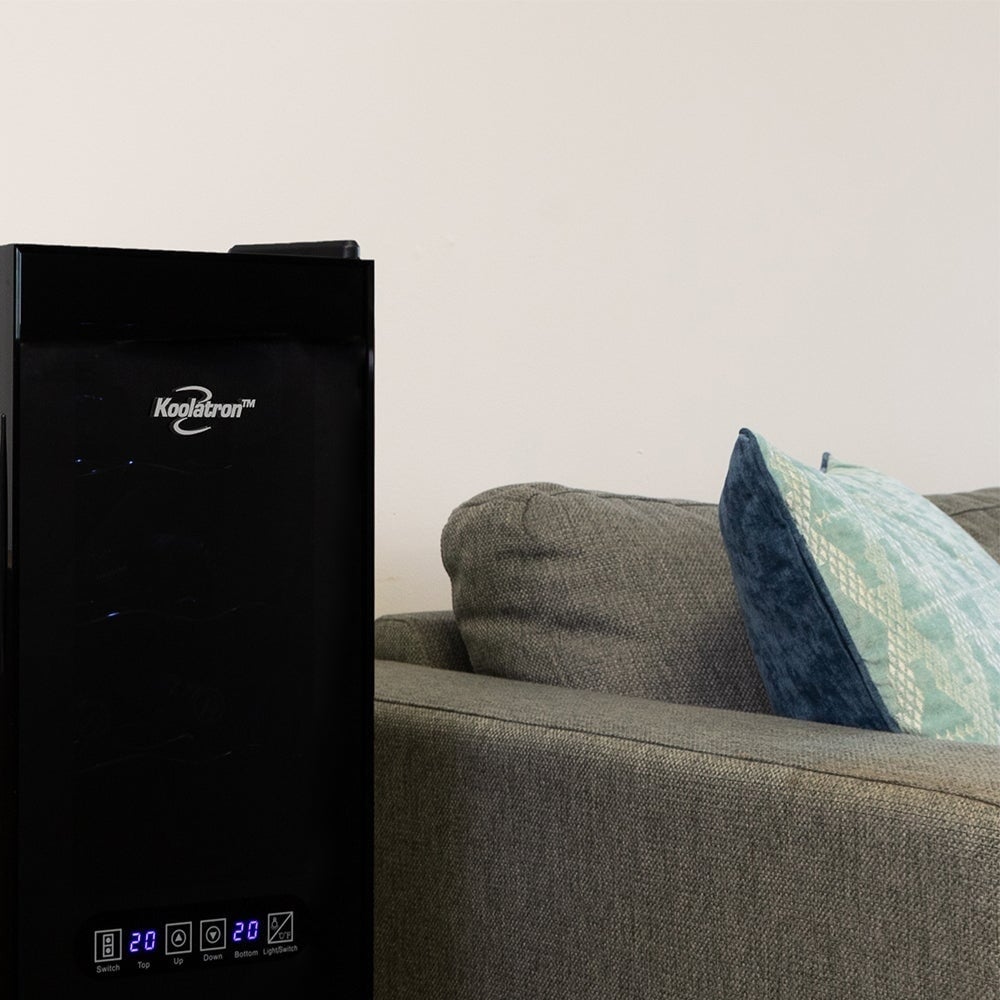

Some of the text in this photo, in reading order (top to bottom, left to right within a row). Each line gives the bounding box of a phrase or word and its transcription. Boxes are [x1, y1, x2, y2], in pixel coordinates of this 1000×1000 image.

[233, 920, 259, 942] 20
[129, 930, 156, 953] 20
[203, 953, 223, 962] Down
[234, 949, 259, 959] Bottom
[137, 961, 151, 970] Top
[173, 957, 184, 966] Up
[96, 963, 121, 974] Switch
